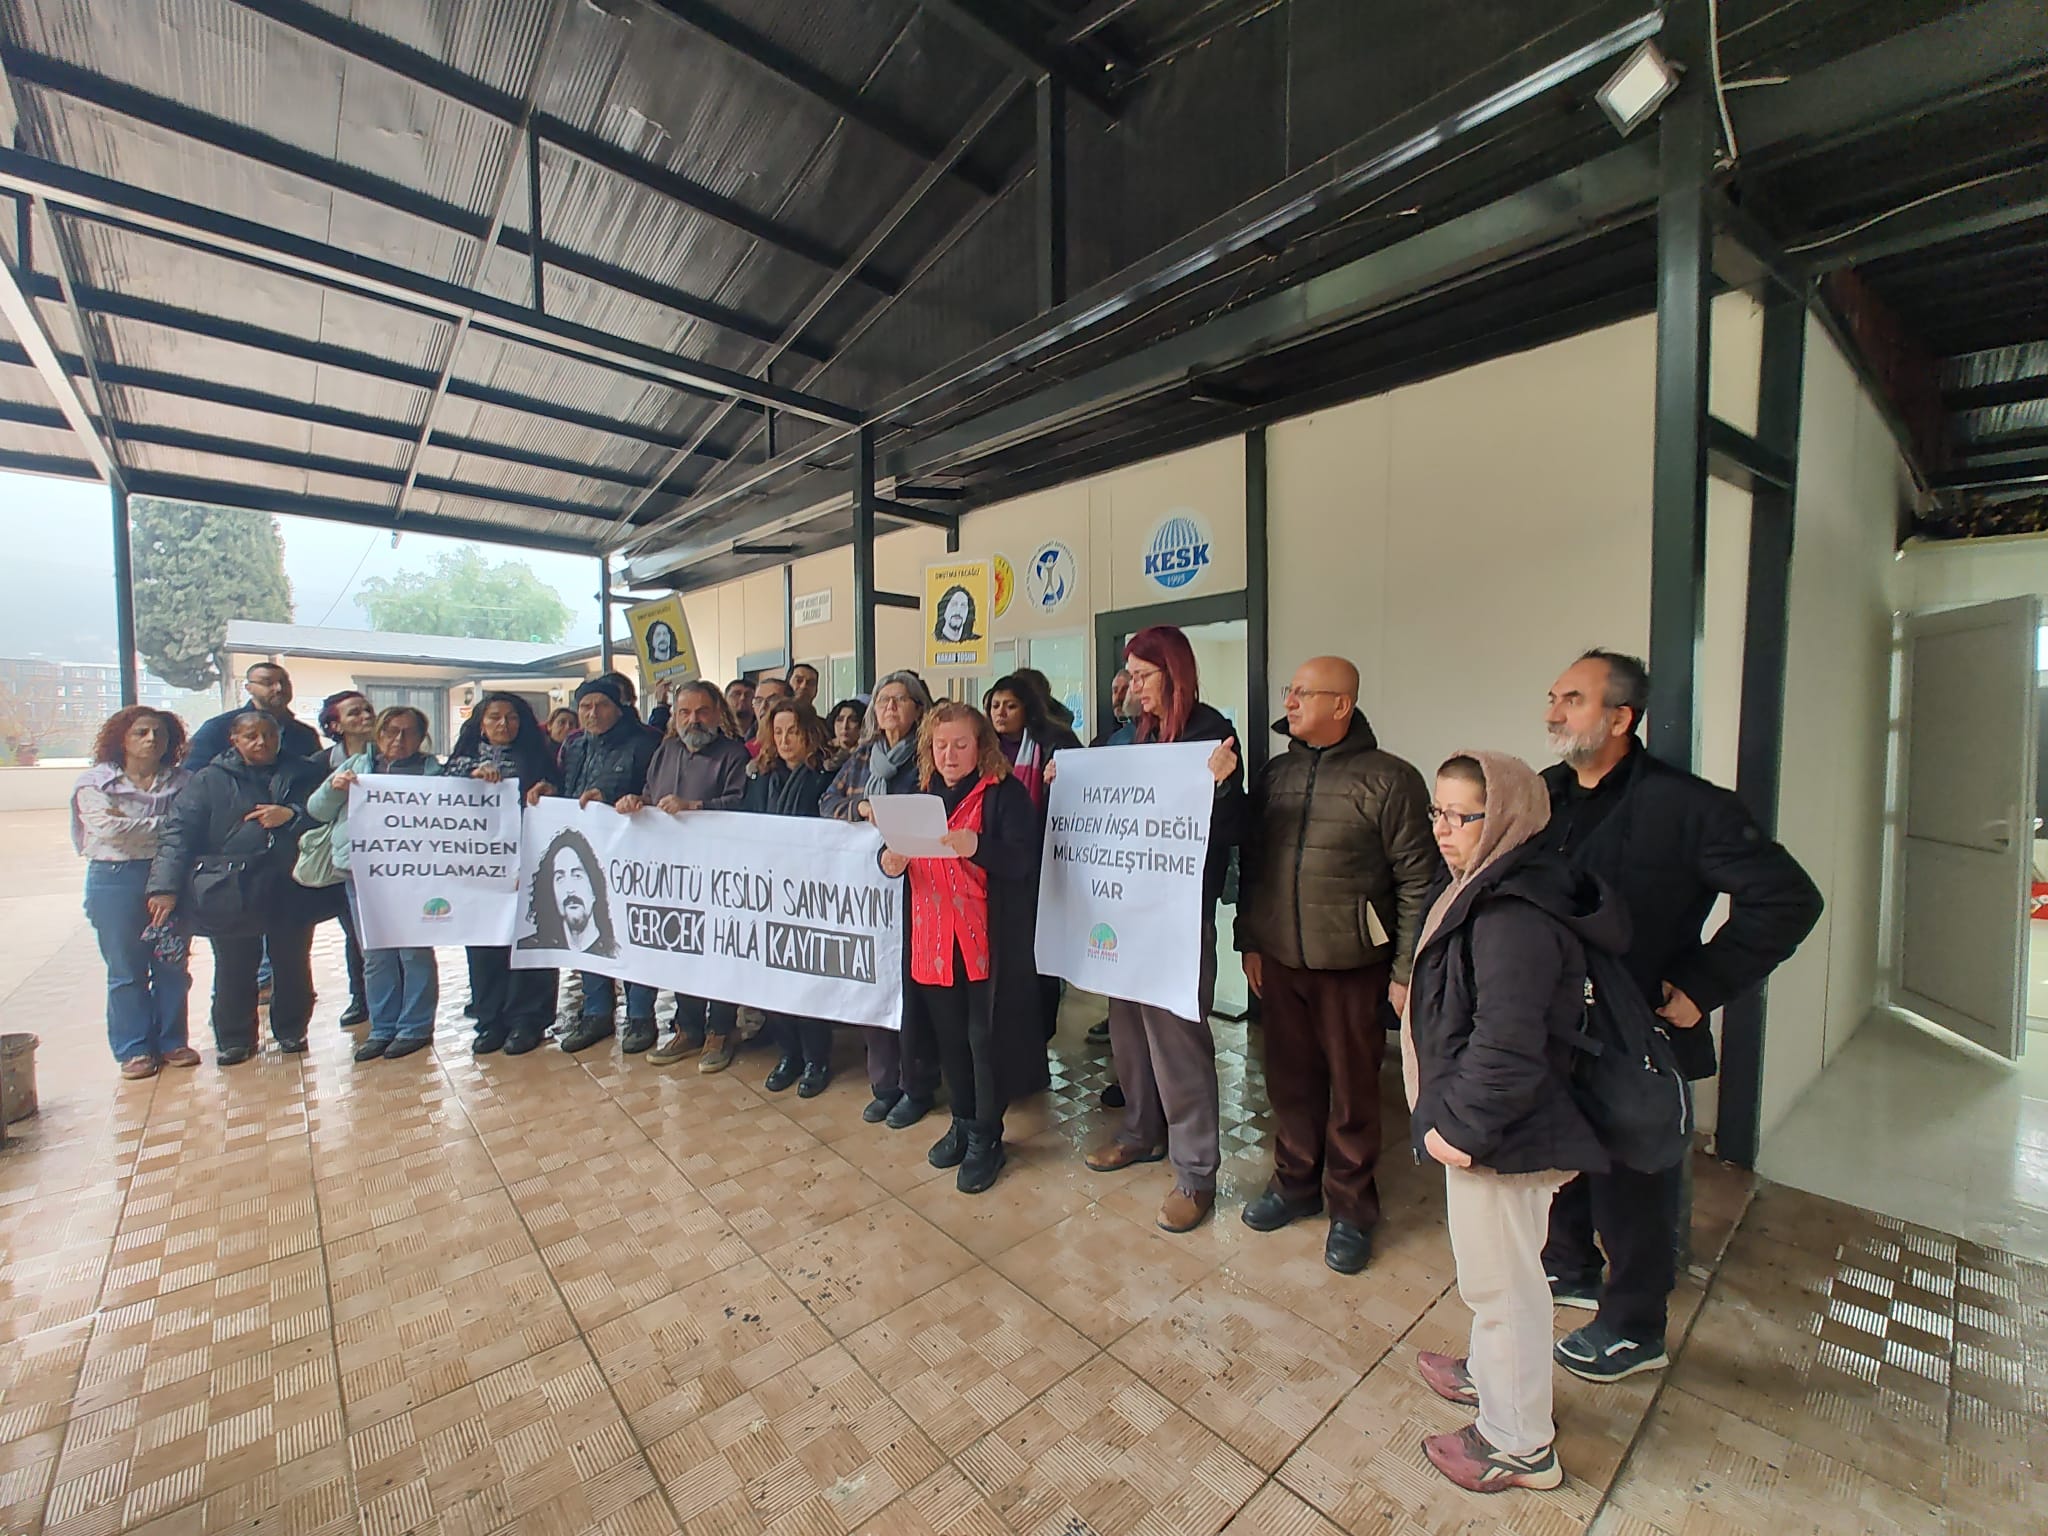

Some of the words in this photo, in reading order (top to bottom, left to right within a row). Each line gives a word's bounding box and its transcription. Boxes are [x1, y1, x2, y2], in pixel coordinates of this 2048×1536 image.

[1145, 543, 1209, 575] KESK
[366, 790, 432, 806] HATAY
[438, 793, 501, 807] HALKI
[1083, 786, 1156, 804] HATAY'DA
[384, 815, 488, 831] OLMADAN
[1051, 811, 1103, 834] YENİDEN
[1104, 813, 1139, 841] İNŞA
[1145, 815, 1206, 845] DEĞİL,
[351, 839, 423, 853] HATAY
[428, 838, 517, 855] YENİDEN
[369, 863, 507, 878] KURULAMAZ!
[610, 859, 702, 903] GÖRÜNTÜ
[711, 866, 773, 913] KESİLDİ
[783, 878, 894, 929] SANMAYIN!
[1092, 879, 1123, 900] VAR
[628, 906, 704, 952] GERÇEK
[713, 915, 760, 961] HÂLÂ
[769, 925, 872, 979] KAYITTA!
